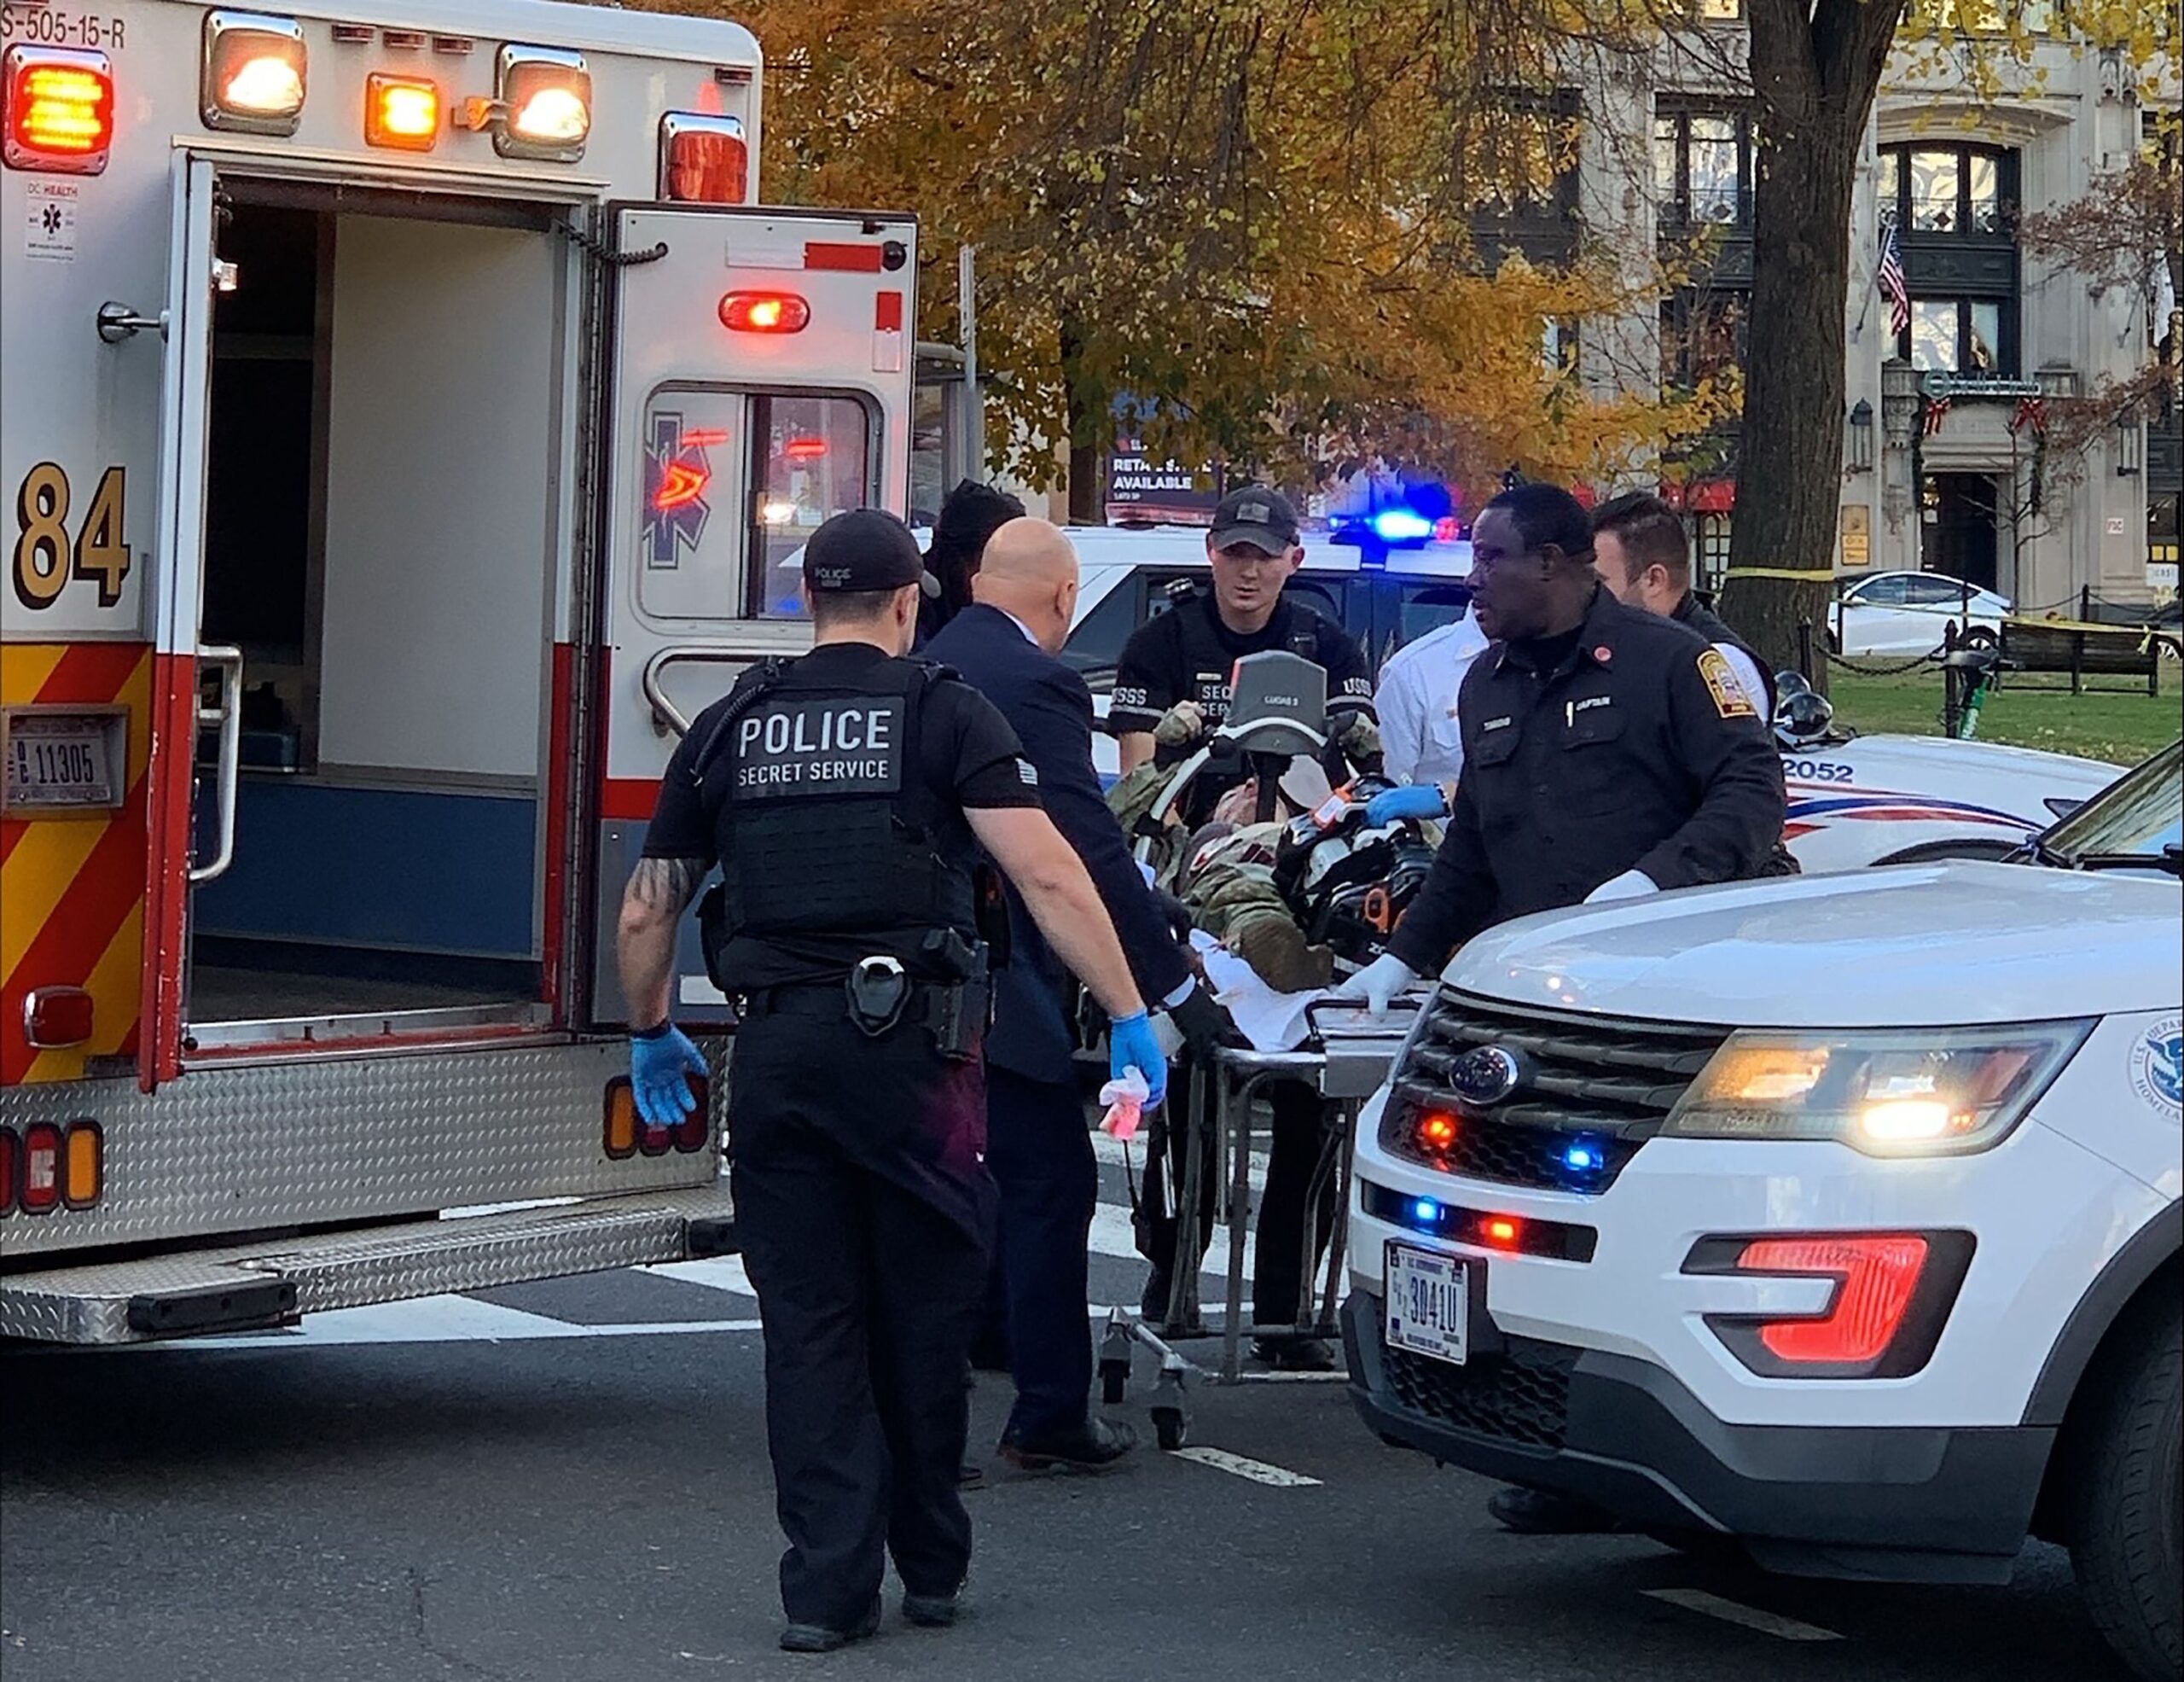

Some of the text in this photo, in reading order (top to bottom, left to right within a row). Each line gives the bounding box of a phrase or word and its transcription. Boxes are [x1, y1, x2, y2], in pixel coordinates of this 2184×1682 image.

[2, 7, 125, 49] S-505-15-R
[1113, 458, 1164, 472] RETA
[1113, 476, 1192, 490] AVAILABLE
[13, 461, 131, 610] 84
[815, 567, 852, 579] POLICE
[1344, 678, 1373, 697] USSS
[1264, 695, 1292, 707] LUCAS
[739, 709, 892, 758] POLICE
[36, 743, 94, 784] 11305
[738, 760, 889, 787] SECRET SERVICE
[1782, 759, 1854, 783] 2052
[1410, 1276, 1457, 1333] 3041U
